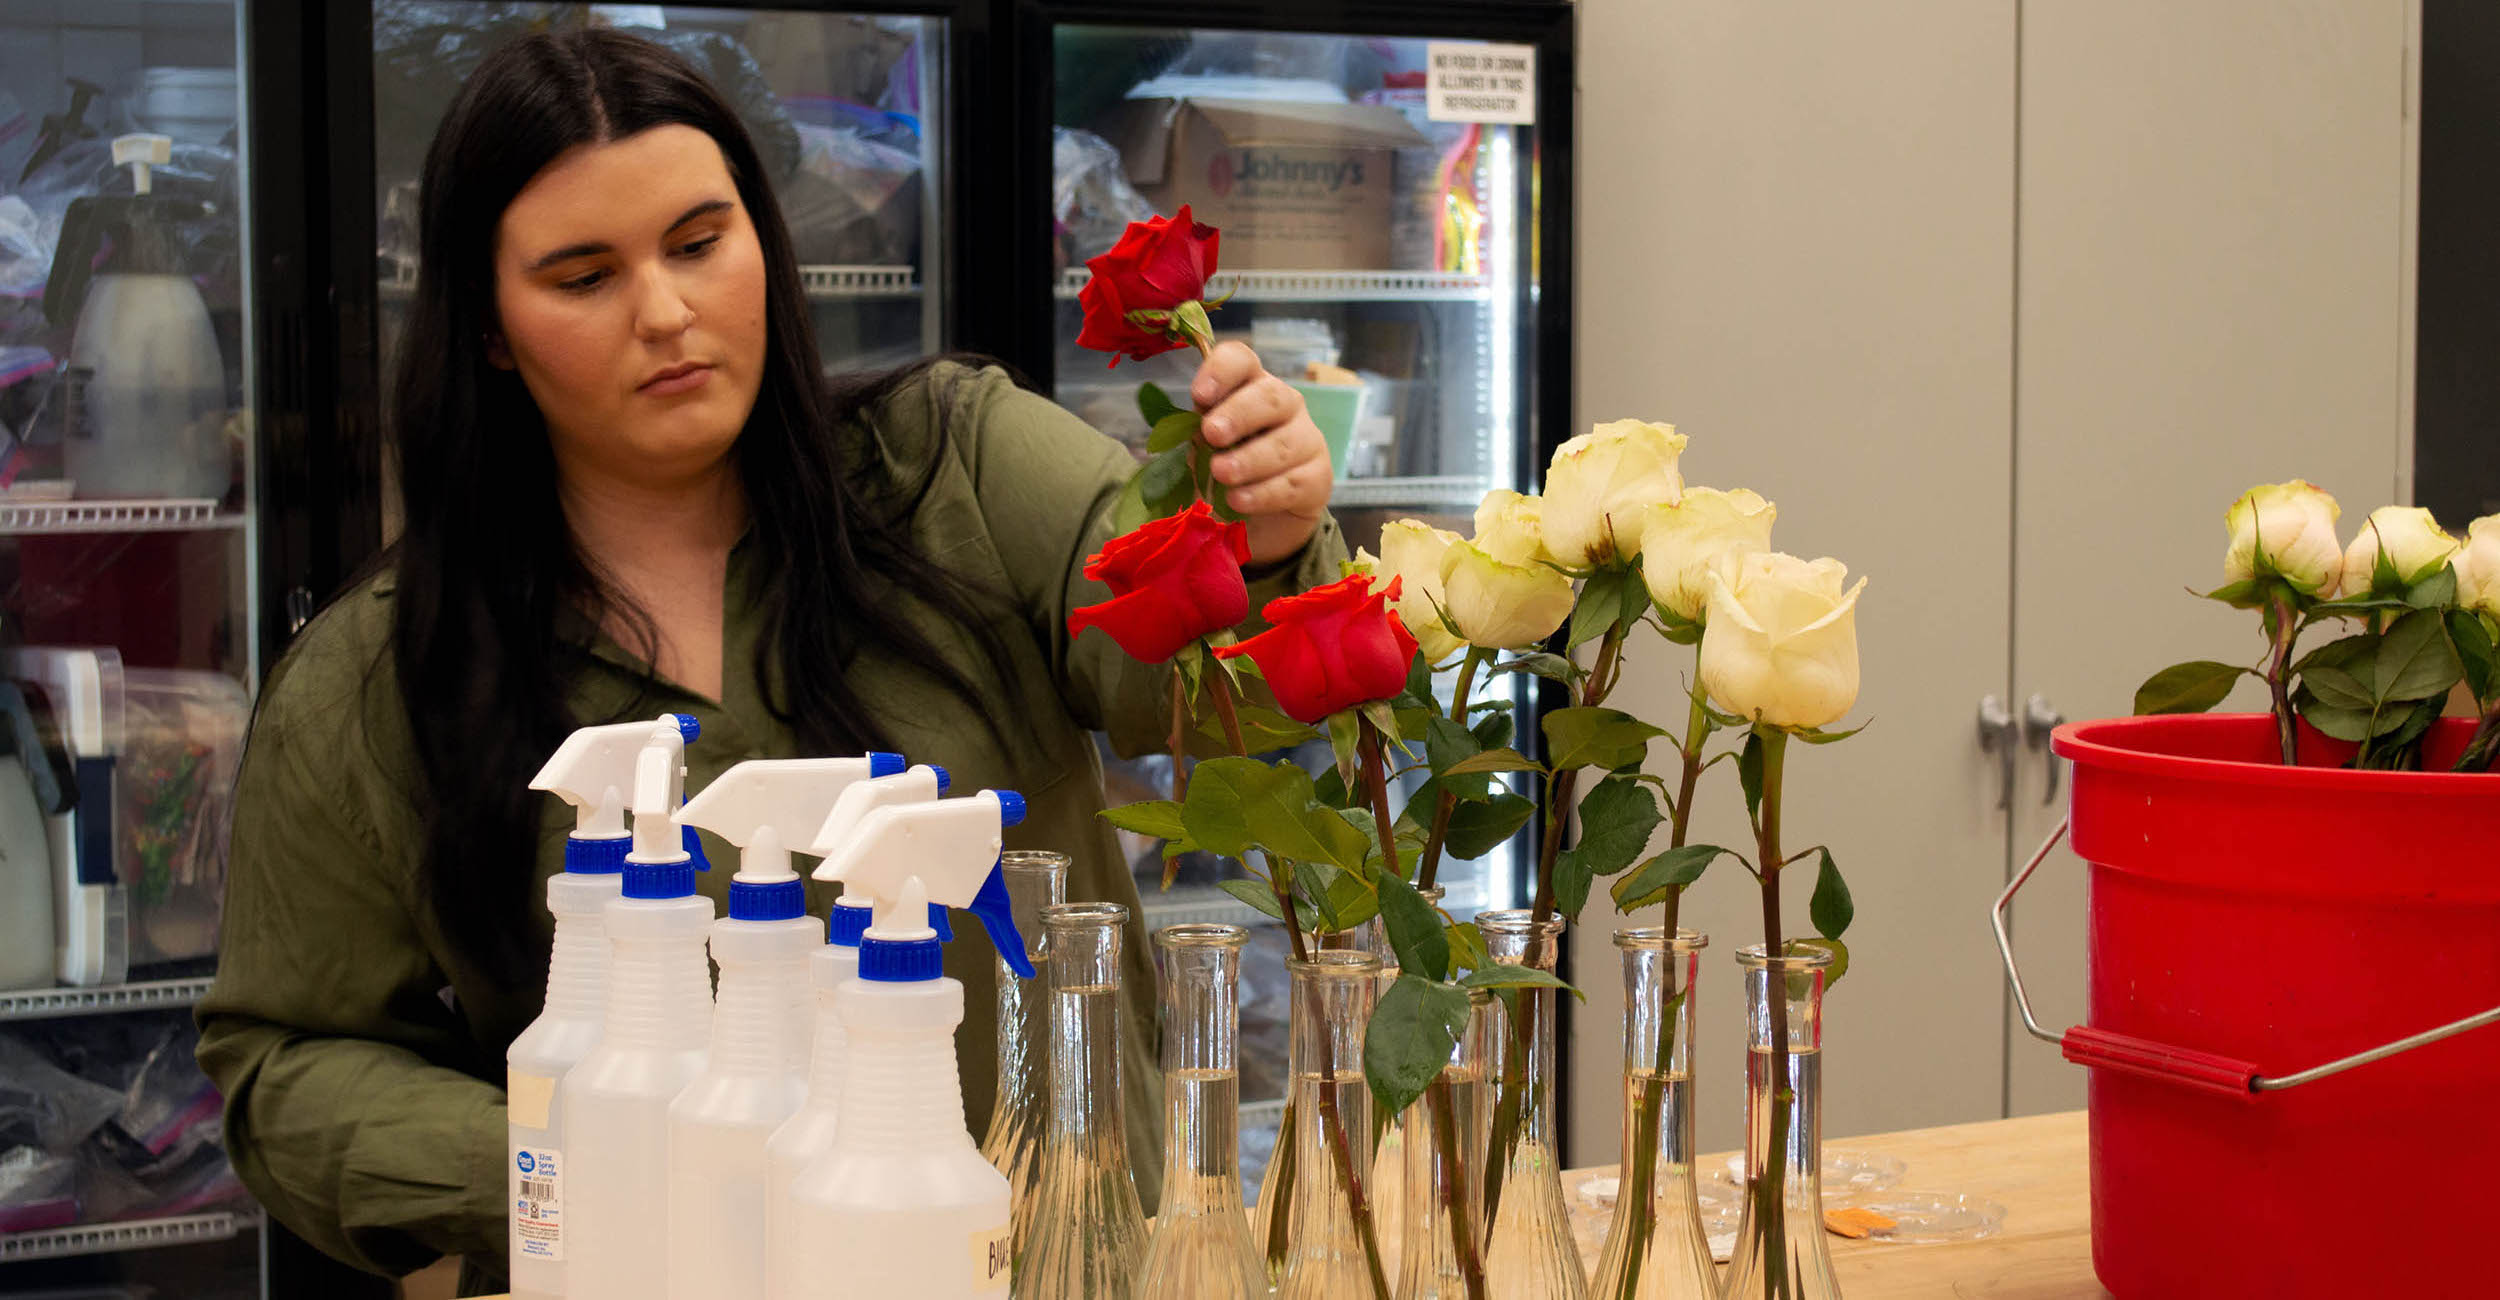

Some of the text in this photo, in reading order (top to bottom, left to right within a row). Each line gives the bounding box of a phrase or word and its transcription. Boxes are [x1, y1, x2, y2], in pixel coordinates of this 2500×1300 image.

[1435, 55, 1526, 71] NO FOOD OR DRINK
[1439, 75, 1484, 90] ALLOWED
[1504, 78, 1522, 91] THIS
[1444, 95, 1517, 110] REFRIGERATOR
[1234, 150, 1365, 192] Johnny's
